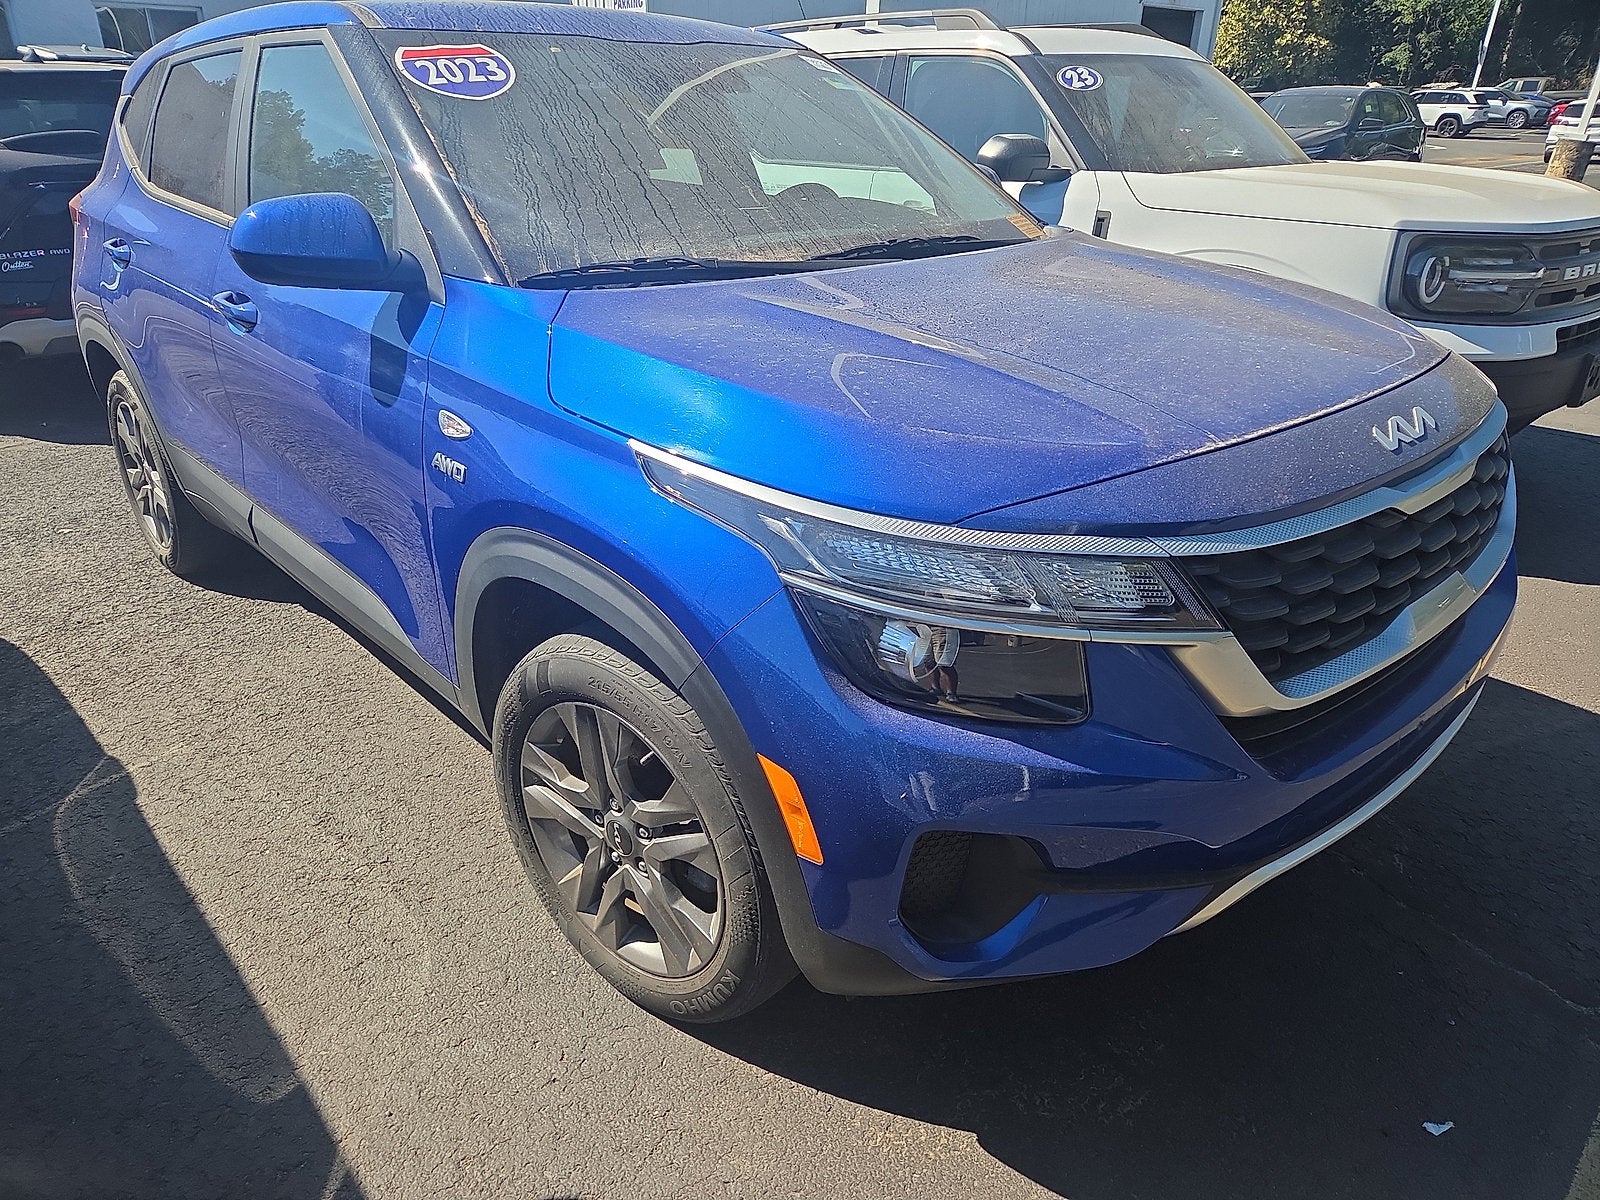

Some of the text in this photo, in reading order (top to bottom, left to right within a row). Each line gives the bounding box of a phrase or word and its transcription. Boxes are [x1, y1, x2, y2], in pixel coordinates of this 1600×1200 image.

[414, 57, 507, 85] 2023
[1065, 67, 1095, 88] 23
[0, 249, 45, 260] BLAZER
[1563, 262, 1600, 281] BR
[1372, 406, 1436, 451] KIA
[431, 452, 468, 483] AWD
[669, 968, 743, 1016] KUMHO
